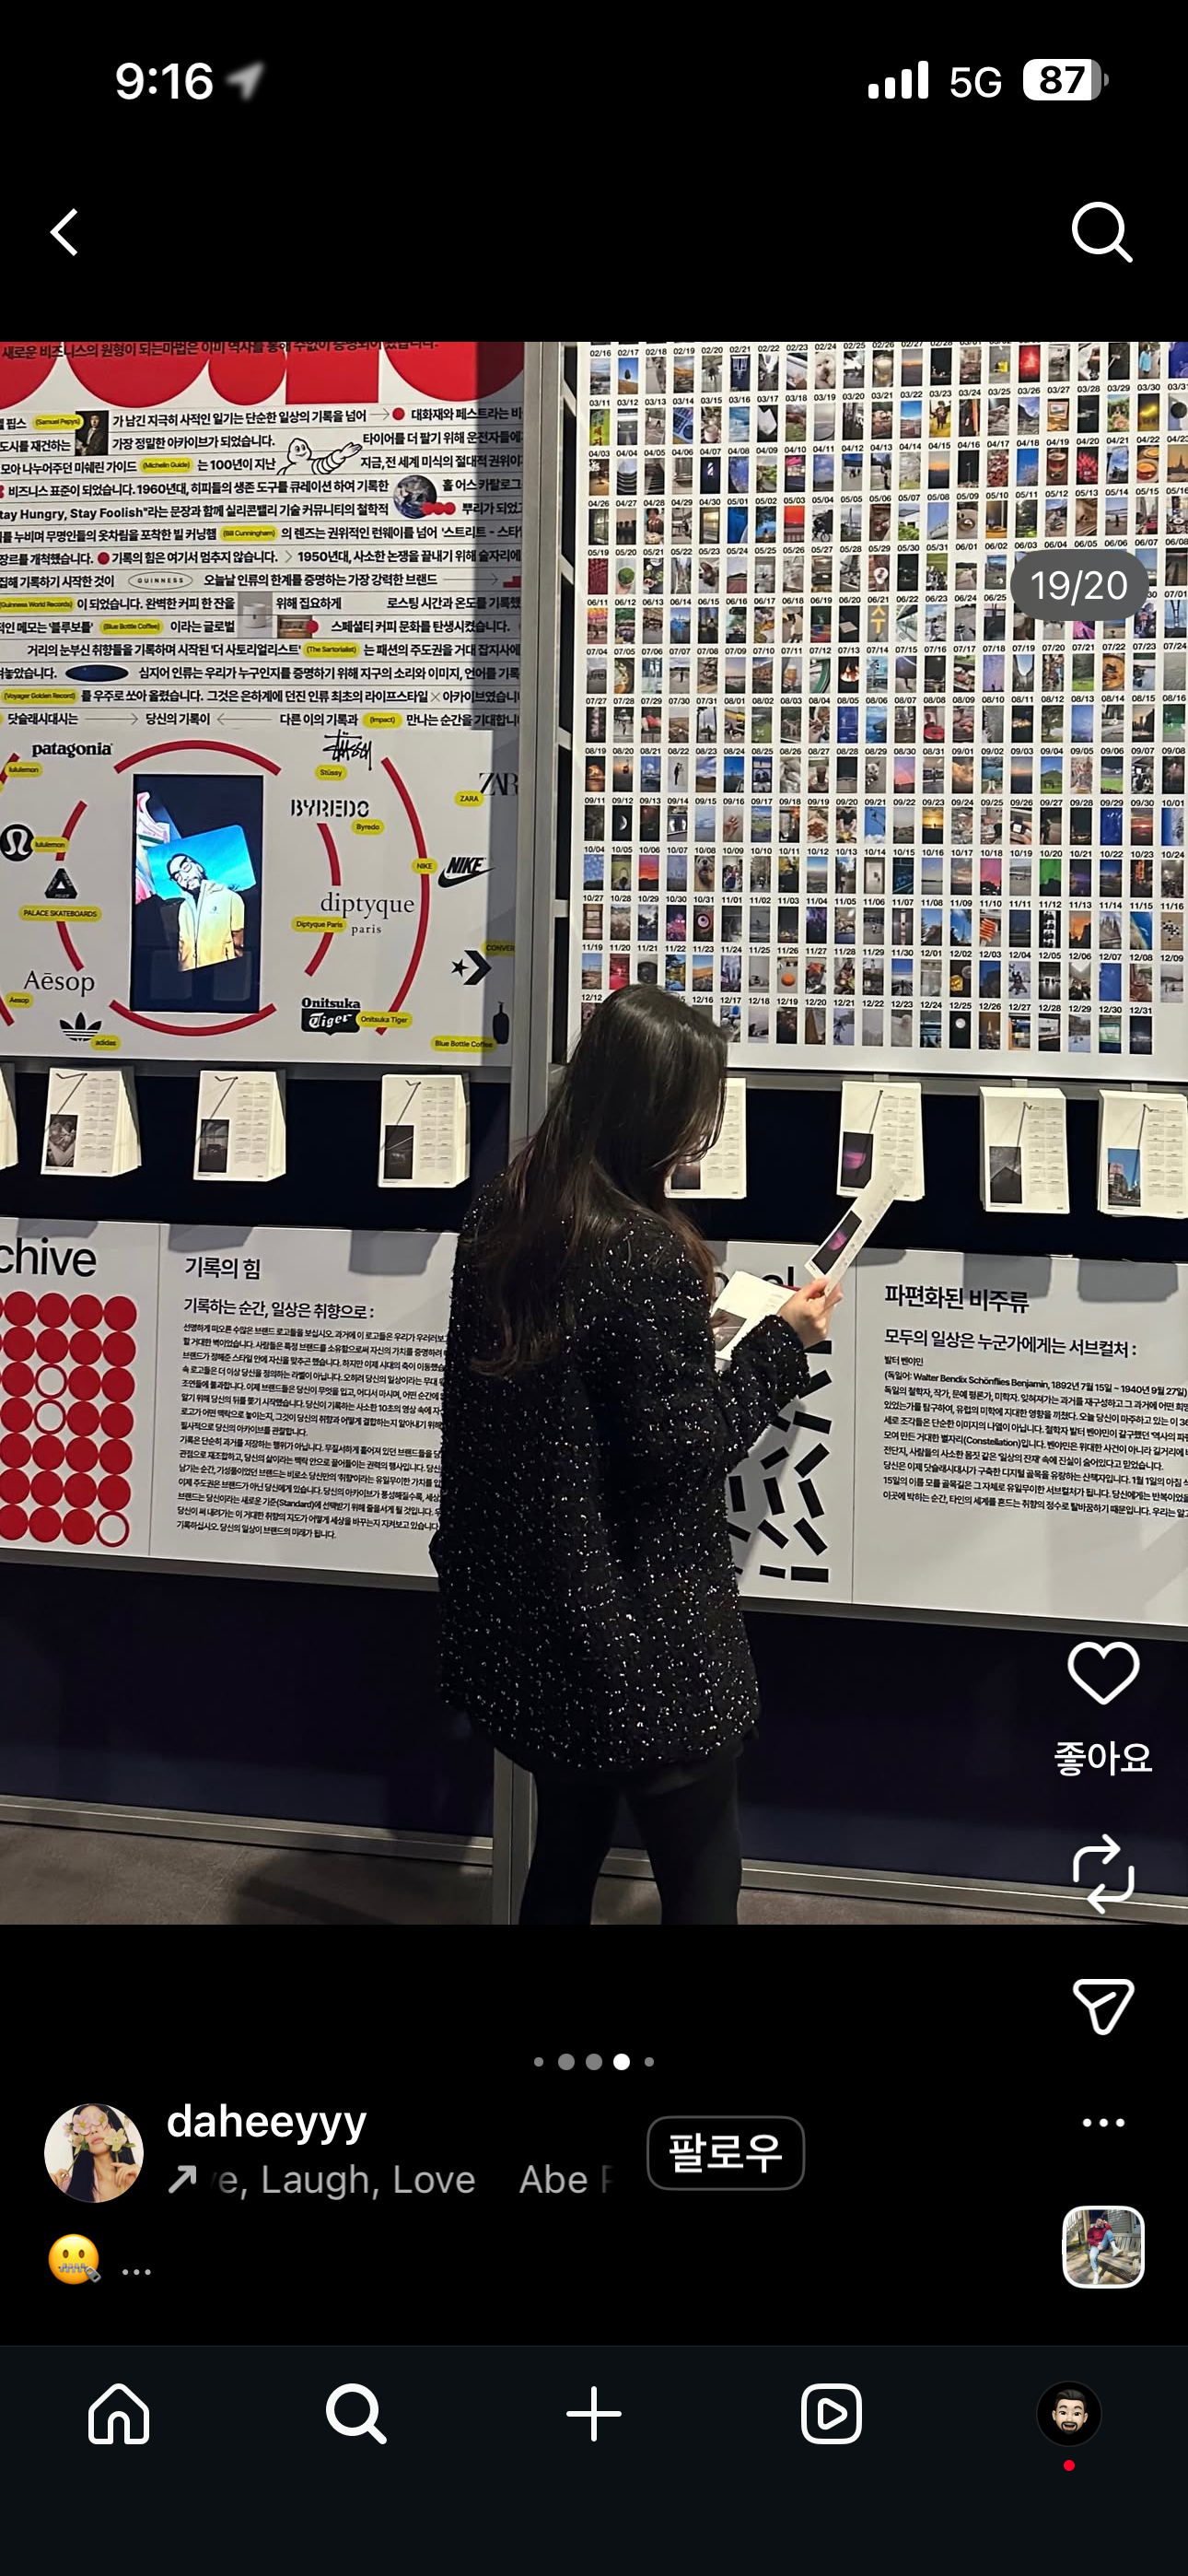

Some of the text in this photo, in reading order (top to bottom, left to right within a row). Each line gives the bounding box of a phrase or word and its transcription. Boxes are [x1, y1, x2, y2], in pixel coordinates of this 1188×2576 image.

[590, 349, 611, 357] 02/16
[758, 345, 779, 353] 02/22
[1137, 383, 1160, 392] 03/30
[589, 399, 610, 407] 03/11
[113, 416, 123, 427] 가
[126, 415, 146, 427] 남긴
[148, 414, 178, 427] 지극히
[181, 414, 210, 426] 사적인
[213, 413, 244, 425] 일기는
[246, 412, 277, 424] 단순한
[279, 411, 309, 423] 일상의
[312, 411, 343, 423] 기록을
[346, 410, 366, 422] 넘어
[412, 408, 454, 420] 대화재와
[456, 407, 508, 421] 페스트라는
[1017, 439, 1039, 448] 04/18
[700, 448, 721, 456] 04/07
[75, 462, 104, 474] 미쉐린
[107, 461, 137, 473] 가이드
[198, 460, 208, 471] 는
[211, 459, 252, 470] 100년이
[255, 458, 276, 470] 지난
[1136, 487, 1159, 496] 05/15
[841, 495, 862, 504] 05/05
[20, 509, 67, 521] Hungry,
[70, 509, 97, 520] Stay
[170, 506, 201, 517] 문장과
[204, 505, 223, 517] 함께
[226, 504, 276, 517] 실리콘밸리
[280, 504, 300, 516] 기술
[303, 504, 355, 516] 커뮤니티의
[357, 503, 388, 515] 철학적
[727, 547, 748, 556] 05/24
[1164, 590, 1186, 599] 07/01
[726, 597, 747, 605] 06/16
[307, 646, 320, 654] (The
[1102, 643, 1125, 651] 07/22
[587, 648, 607, 656] 07/04
[1071, 695, 1094, 703] 08/13
[8, 713, 78, 725] 닷슬래시대시는
[146, 713, 210, 725] 당신의 기록이
[280, 713, 472, 726] 다른 이의 기록과 (Impact) 만나는 순간을
[1041, 747, 1063, 755] 09/04
[320, 768, 342, 778] Stüssy
[291, 800, 368, 817] BYREDO
[356, 823, 379, 832] Byredo
[723, 847, 743, 855] 10/09
[1162, 850, 1184, 859] 10/24
[416, 861, 433, 871] NIKE
[447, 857, 483, 873] NIKE
[321, 892, 413, 919] diptyque
[1130, 902, 1153, 910] 11/15
[51, 909, 97, 918] SKATEBOARDS
[297, 920, 343, 929] Diptyque Paris
[352, 925, 381, 936] paris
[583, 943, 602, 952] 11/19
[1160, 954, 1183, 963] 12/09
[24, 969, 94, 997] Aēsop
[9, 997, 29, 1005] Aesop
[302, 998, 360, 1010] Onitsuka
[1130, 1006, 1151, 1014] 12/31
[309, 1013, 352, 1028] Tiger
[361, 1015, 407, 1025] Onitsuka Tiger
[436, 1039, 449, 1048] Blue
[472, 1039, 494, 1049] Coffee
[186, 1257, 260, 1280] 기록의 힘
[885, 1284, 1031, 1313] 파편화된 비주류
[184, 1298, 237, 1315] 기록하는
[239, 1301, 268, 1318] 순간,
[272, 1302, 311, 1317] 일상은
[314, 1304, 367, 1319] 취향으로
[885, 1329, 926, 1346] 모두의
[932, 1331, 974, 1349] 일상은
[978, 1334, 1066, 1353] 누군가에게는
[1069, 1340, 1127, 1358] 서브컬처
[885, 1370, 912, 1380] (독일어:
[914, 1372, 938, 1381] Walter
[940, 1374, 967, 1383] Bendix
[1011, 1379, 1050, 1389] Benjamin,
[1052, 1381, 1078, 1390] 1892년
[1081, 1382, 1093, 1391] 7월
[1095, 1383, 1112, 1392] 15일
[1121, 1385, 1149, 1394] 1940년
[1151, 1386, 1164, 1395] 9월
[1166, 1388, 1187, 1398] 27일)
